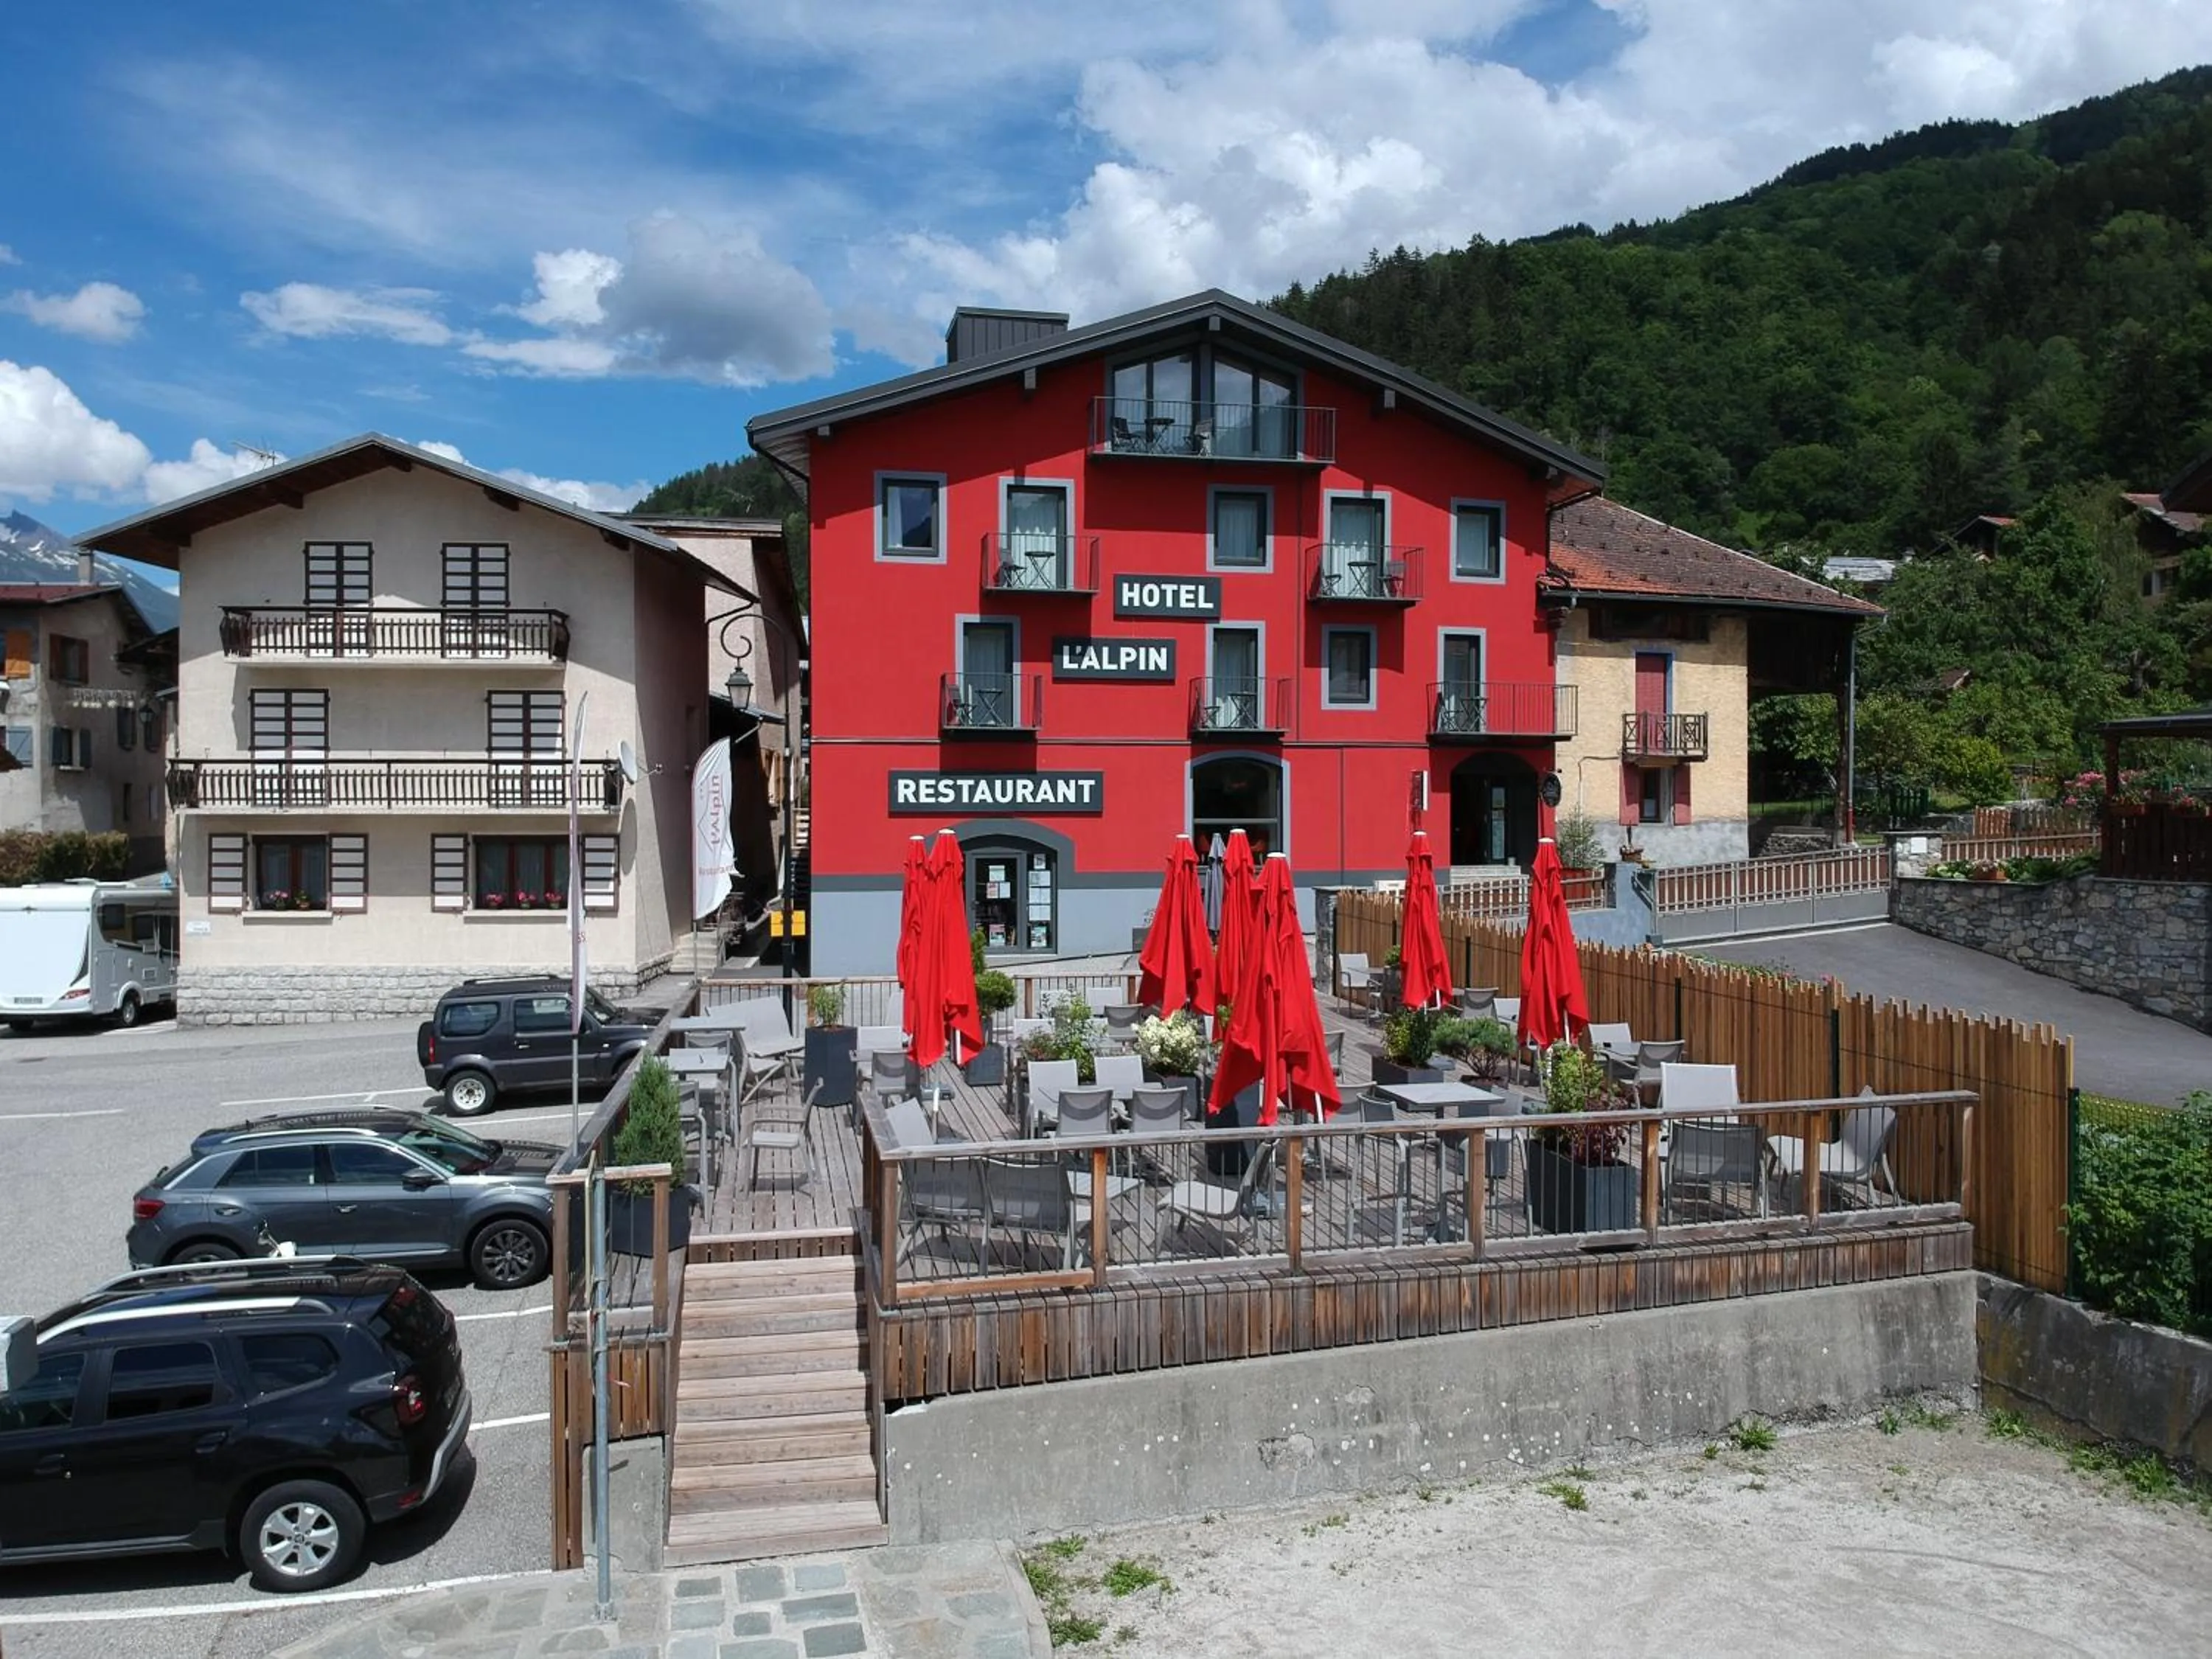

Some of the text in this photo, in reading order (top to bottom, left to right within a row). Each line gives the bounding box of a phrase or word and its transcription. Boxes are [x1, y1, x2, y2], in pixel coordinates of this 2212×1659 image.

[1121, 583, 1214, 608] HOTEL
[1062, 646, 1167, 670] L'ALPIN
[897, 779, 1096, 803] RESTAURANT
